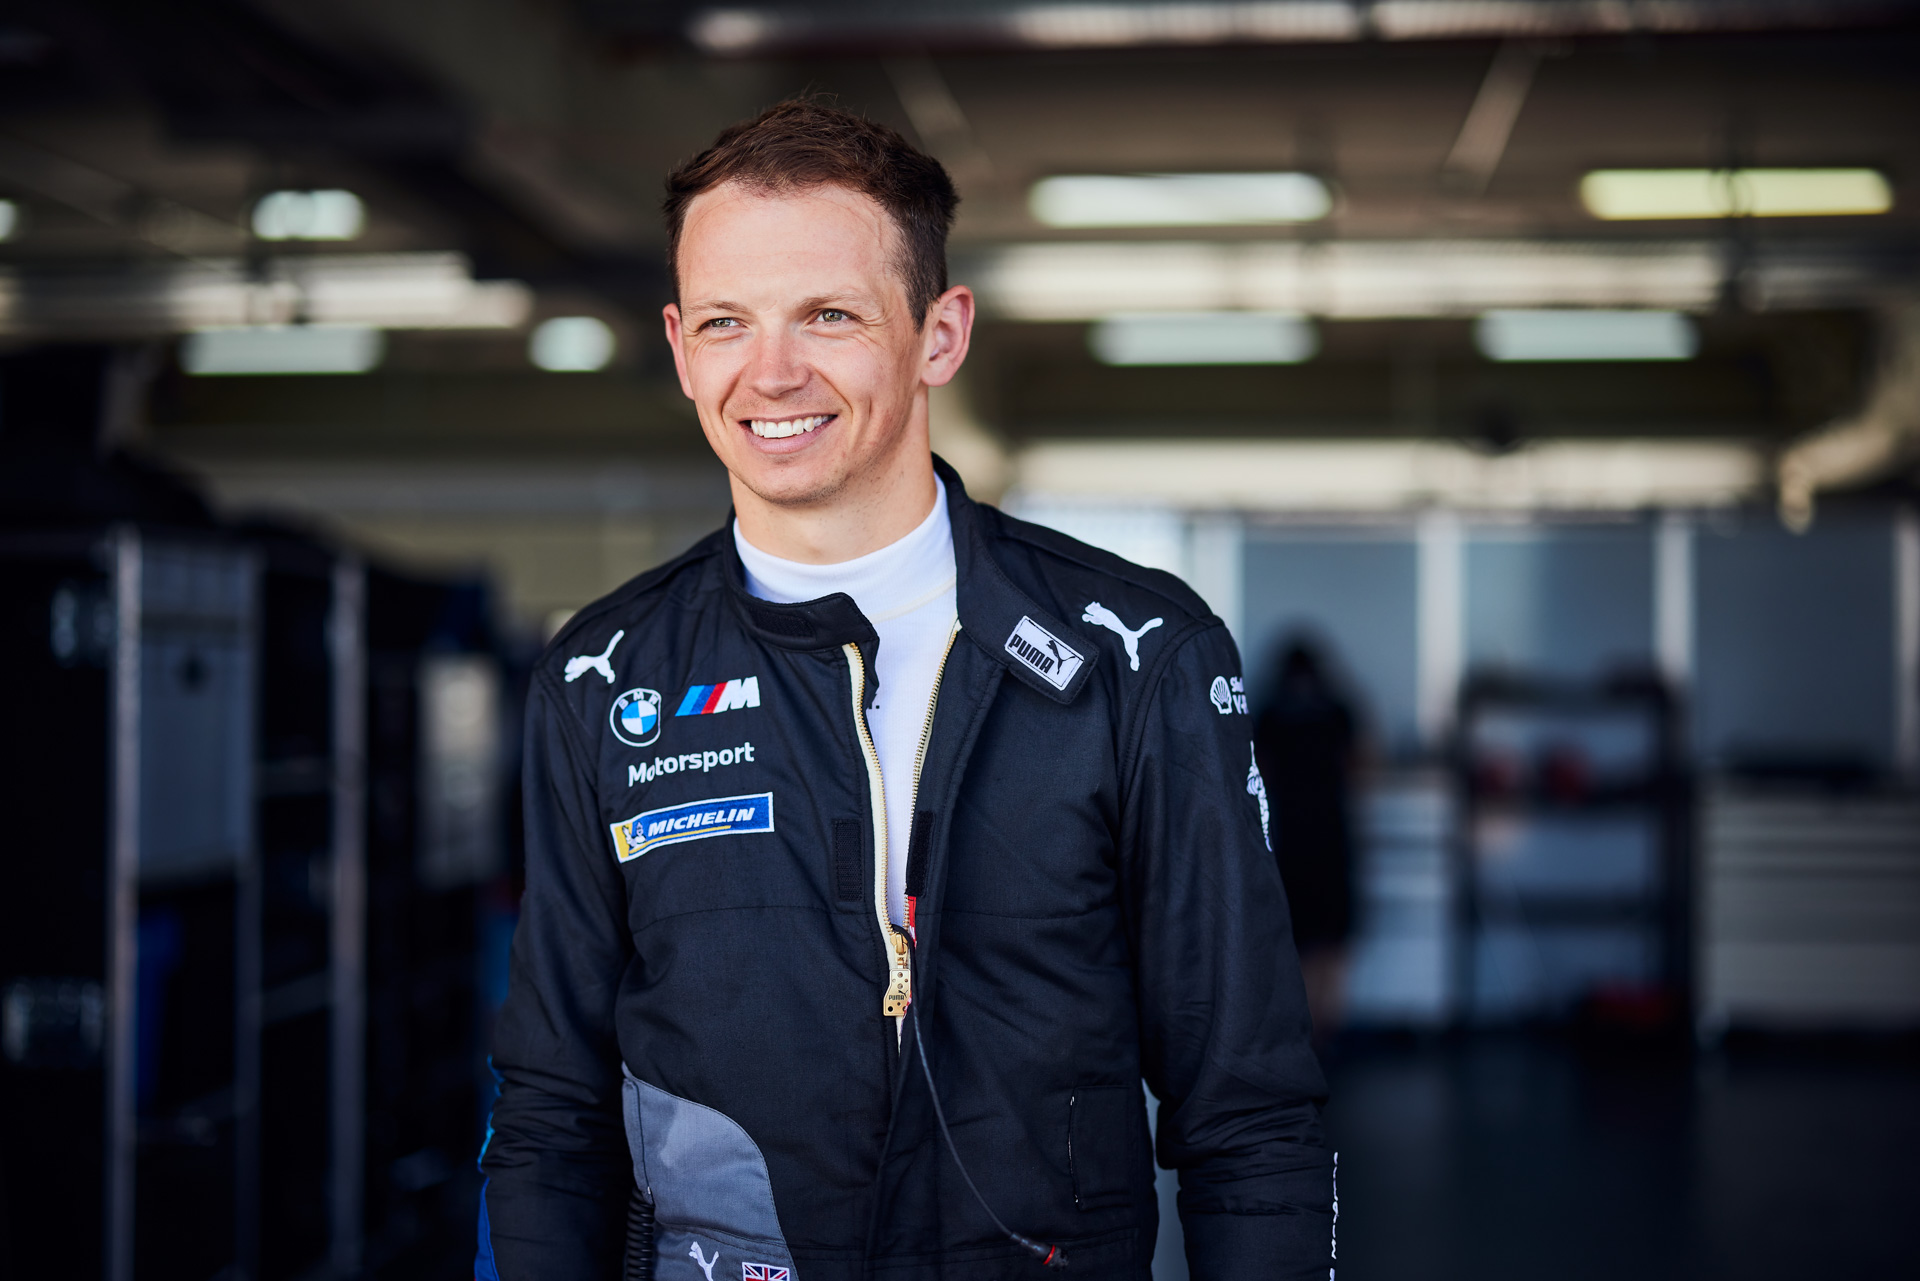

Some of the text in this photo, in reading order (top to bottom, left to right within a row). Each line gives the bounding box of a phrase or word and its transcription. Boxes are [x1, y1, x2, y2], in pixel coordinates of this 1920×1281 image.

[1008, 633, 1055, 674] PUMA
[628, 741, 755, 787] Motorsport
[647, 807, 756, 837] MICHELIN
